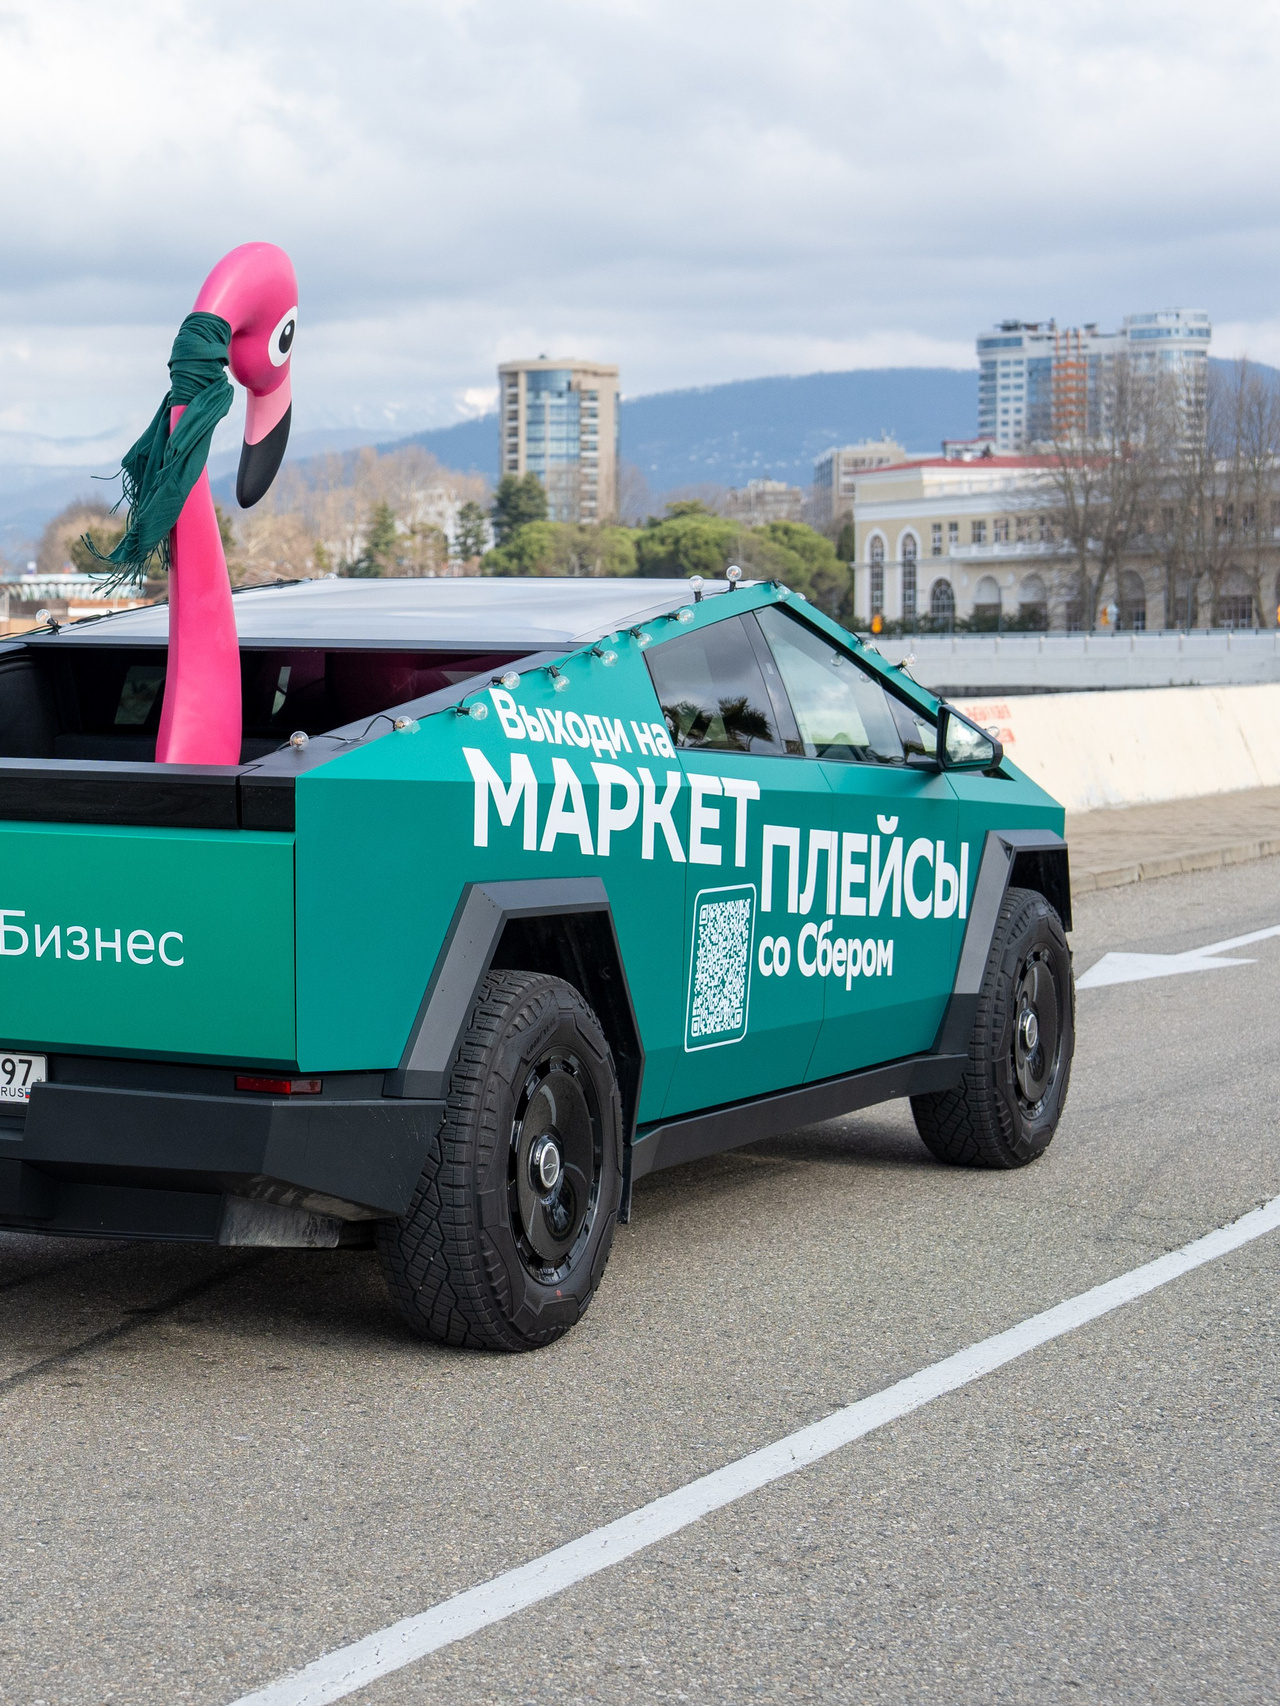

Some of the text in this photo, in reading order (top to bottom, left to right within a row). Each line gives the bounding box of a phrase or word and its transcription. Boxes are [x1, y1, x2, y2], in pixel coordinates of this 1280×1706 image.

[488, 687, 677, 759] Выходи на
[462, 747, 761, 868] МАРКЕТ
[761, 814, 970, 920] ПЛЕЙСЫ
[757, 919, 894, 991] со Сбером
[0, 1086, 25, 1098] RUS
[1, 1057, 33, 1087] 97
